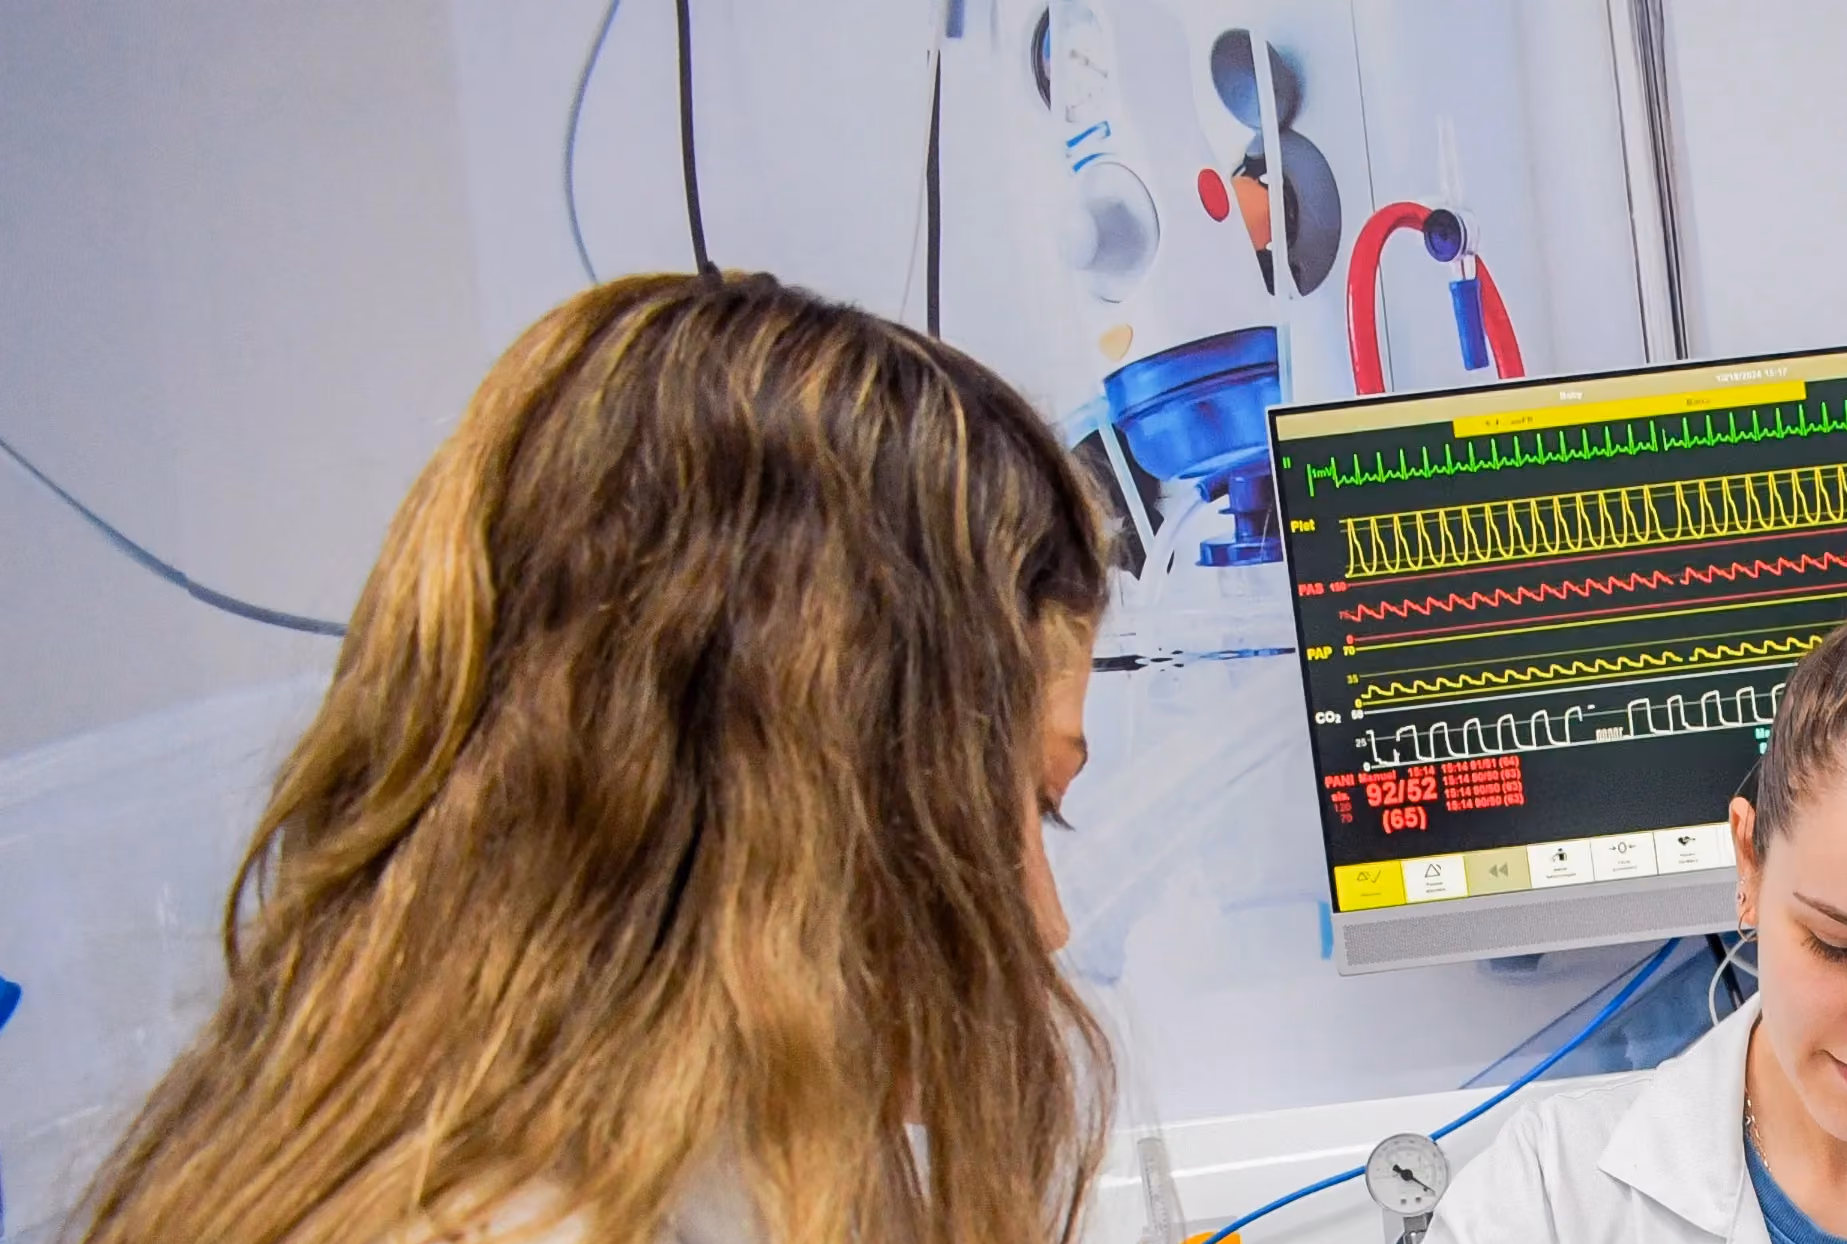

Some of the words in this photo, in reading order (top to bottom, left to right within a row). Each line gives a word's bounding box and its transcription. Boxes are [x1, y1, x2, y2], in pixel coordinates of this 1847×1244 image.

[1306, 646, 1333, 660] PAP
[1366, 776, 1438, 807] 92/52
[1382, 805, 1428, 834] (65)
